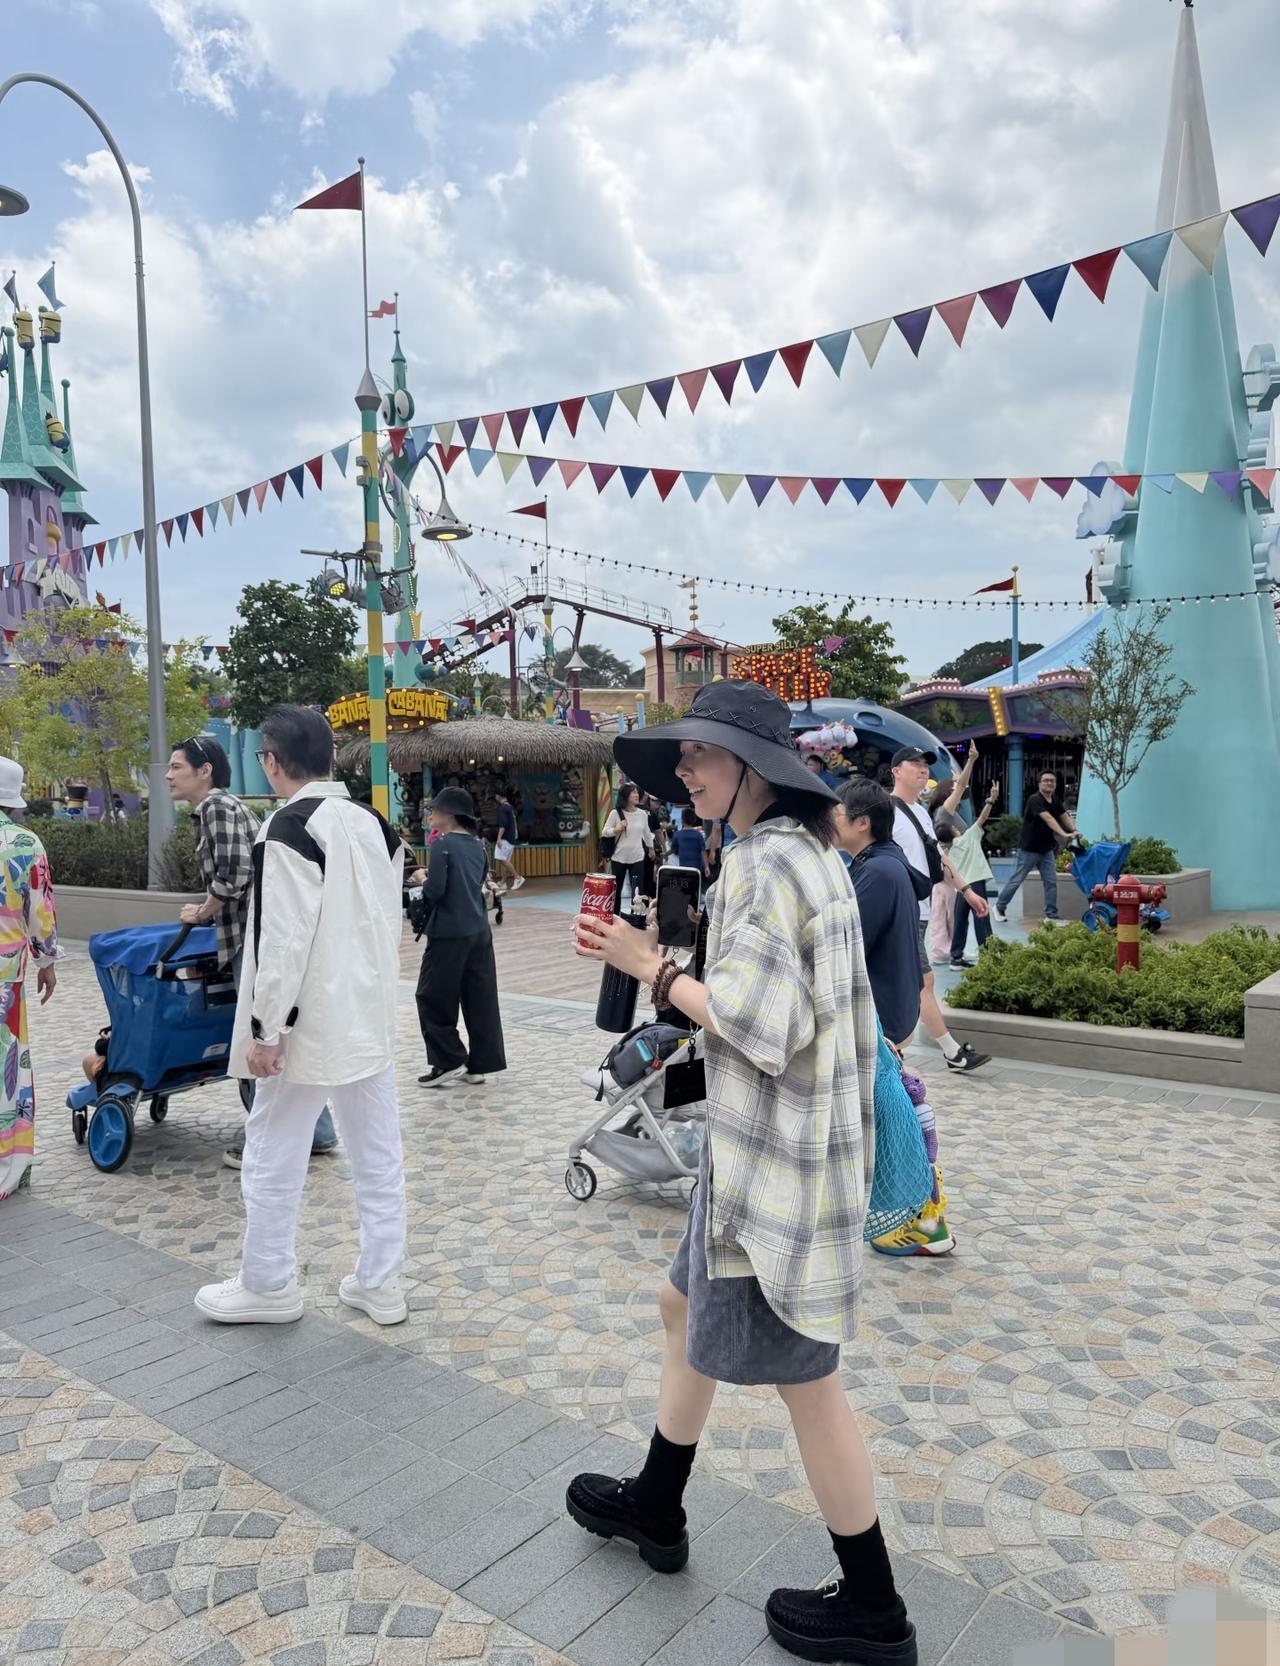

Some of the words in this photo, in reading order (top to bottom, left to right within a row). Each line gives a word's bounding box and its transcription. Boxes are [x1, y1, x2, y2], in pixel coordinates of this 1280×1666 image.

[745, 643, 774, 654] SUPER
[774, 639, 801, 650] SILLY
[731, 646, 817, 683] SPACE
[388, 691, 449, 723] CABANA
